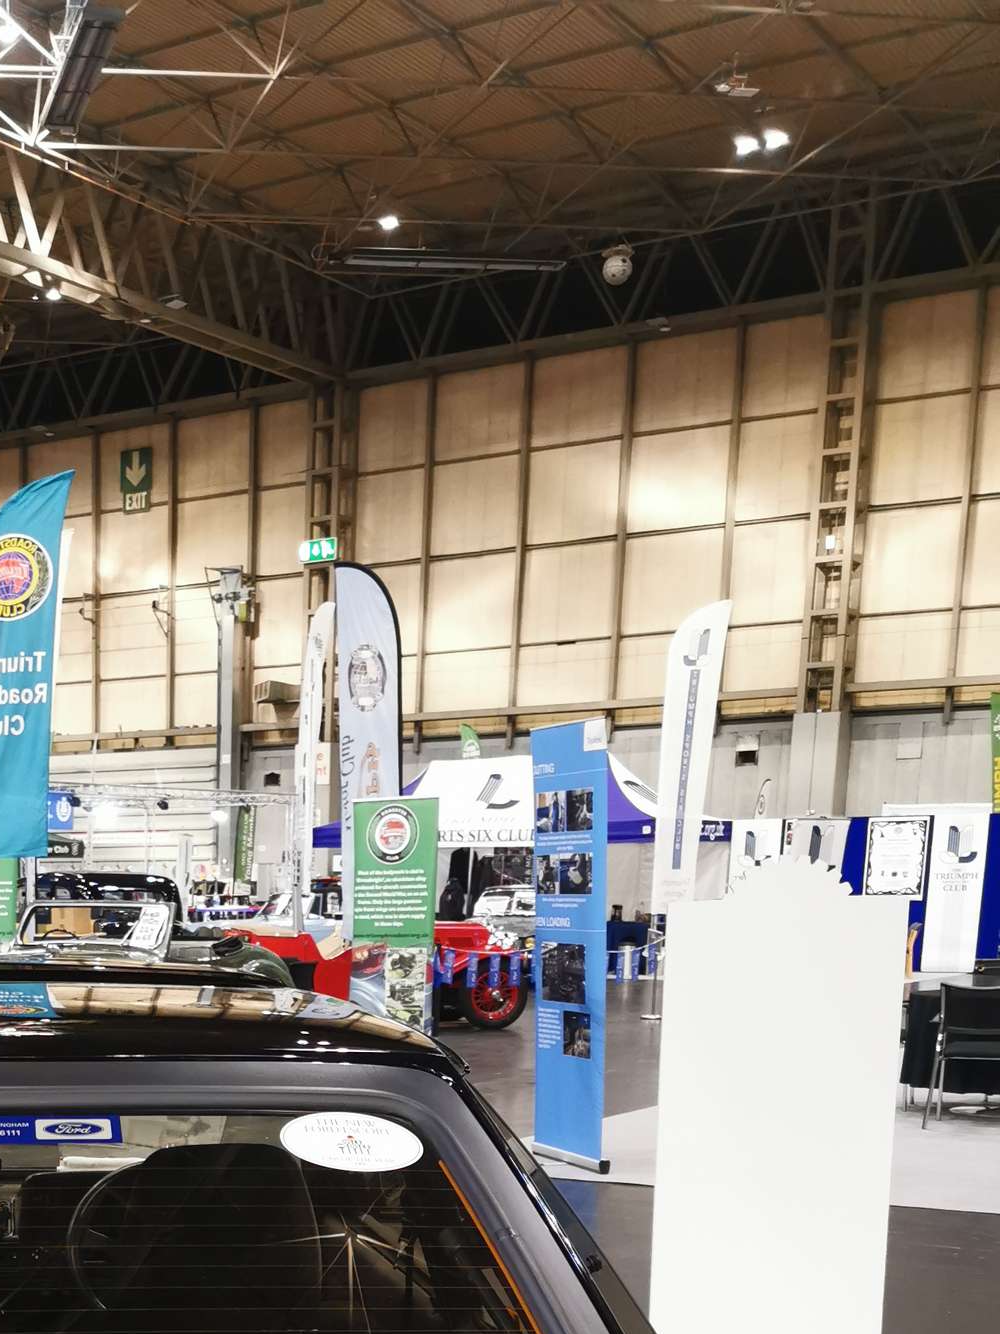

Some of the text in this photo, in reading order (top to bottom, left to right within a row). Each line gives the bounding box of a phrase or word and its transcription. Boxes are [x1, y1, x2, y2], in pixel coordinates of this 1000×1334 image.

[125, 491, 147, 511] EXIT
[468, 829, 494, 842] SIX
[935, 871, 979, 880] TRIUMPH
[943, 883, 968, 892] CLUB
[54, 1122, 91, 1135] Ford
